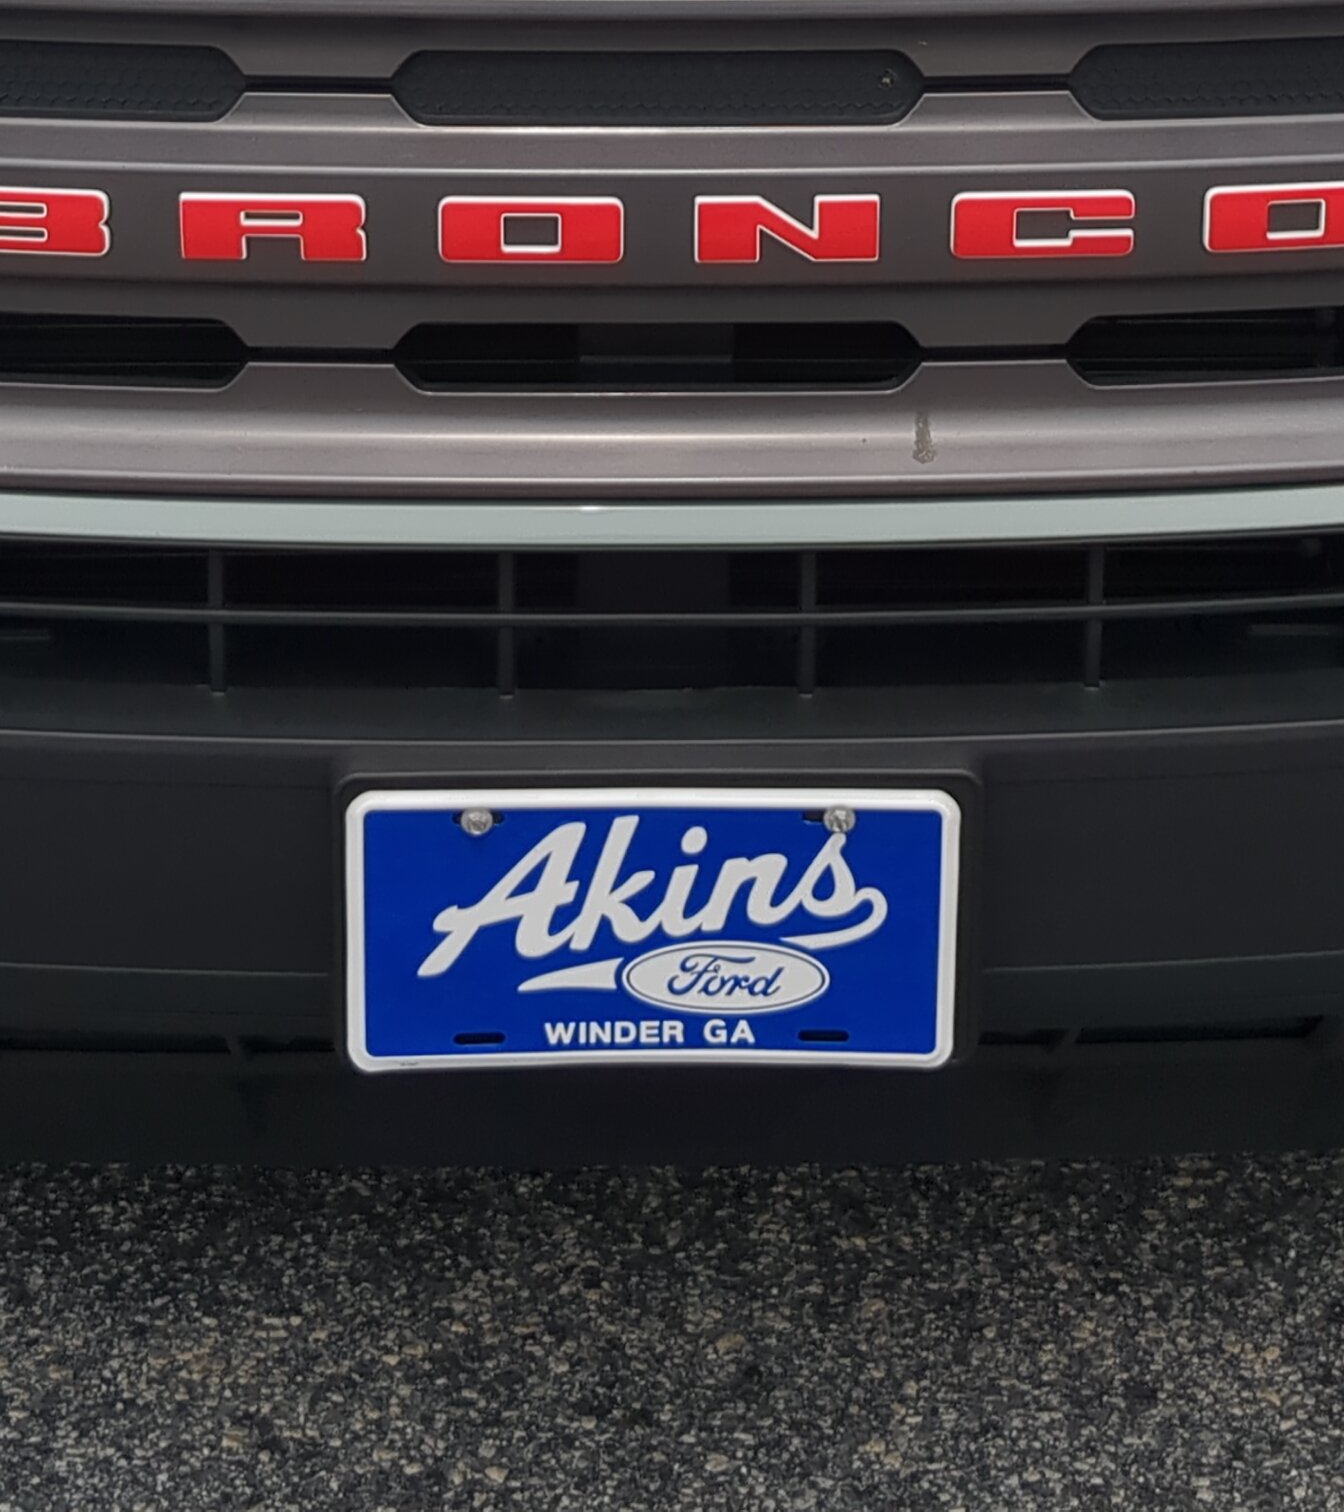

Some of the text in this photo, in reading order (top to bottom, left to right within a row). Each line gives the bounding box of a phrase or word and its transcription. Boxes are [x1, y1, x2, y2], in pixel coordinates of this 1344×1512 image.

[416, 814, 888, 978] Akins
[666, 952, 784, 1000] Ford
[544, 1018, 756, 1046] WINDER GA
